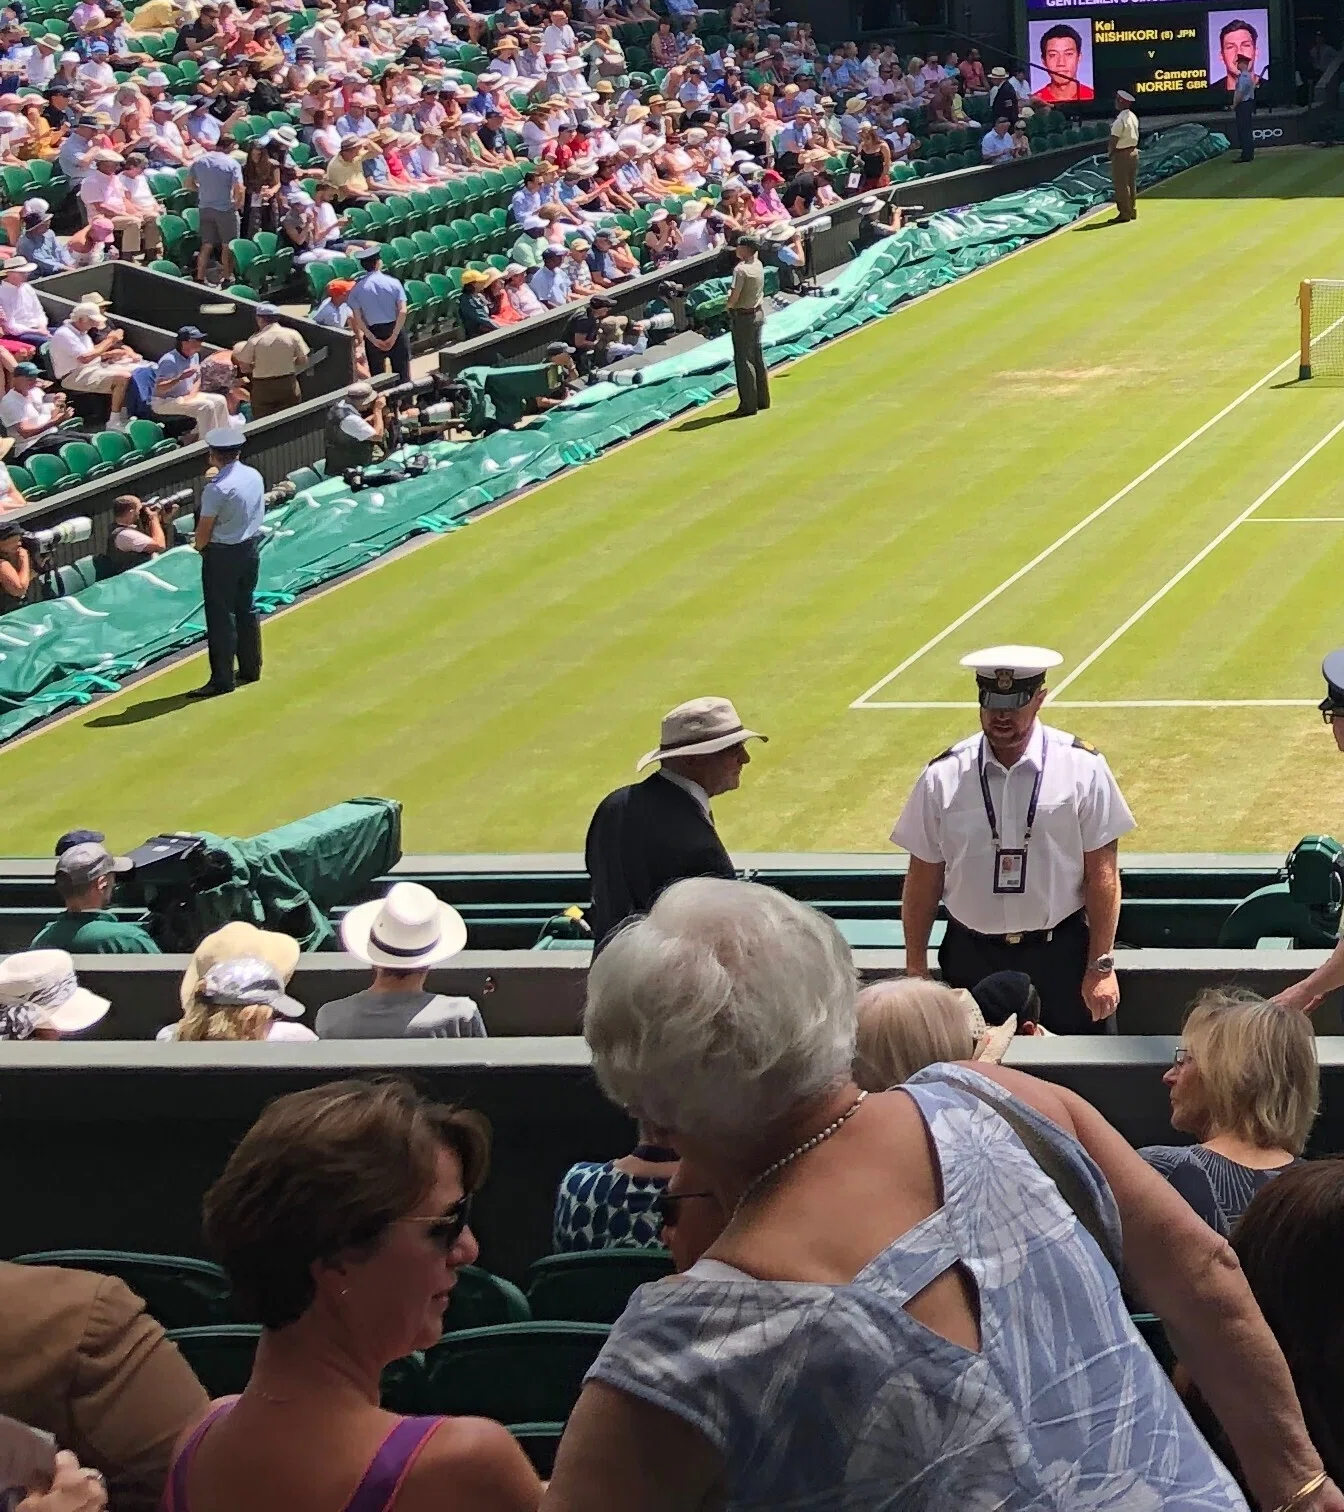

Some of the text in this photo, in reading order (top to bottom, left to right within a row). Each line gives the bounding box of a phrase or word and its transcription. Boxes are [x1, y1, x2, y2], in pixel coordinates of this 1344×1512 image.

[1095, 20, 1115, 31] Kei
[1095, 29, 1158, 43] NISHIKORI
[1176, 28, 1196, 39] JPN
[1154, 68, 1207, 80] Cameron
[1136, 79, 1208, 93] NORRIE GBR
[1252, 128, 1283, 140] ppo
